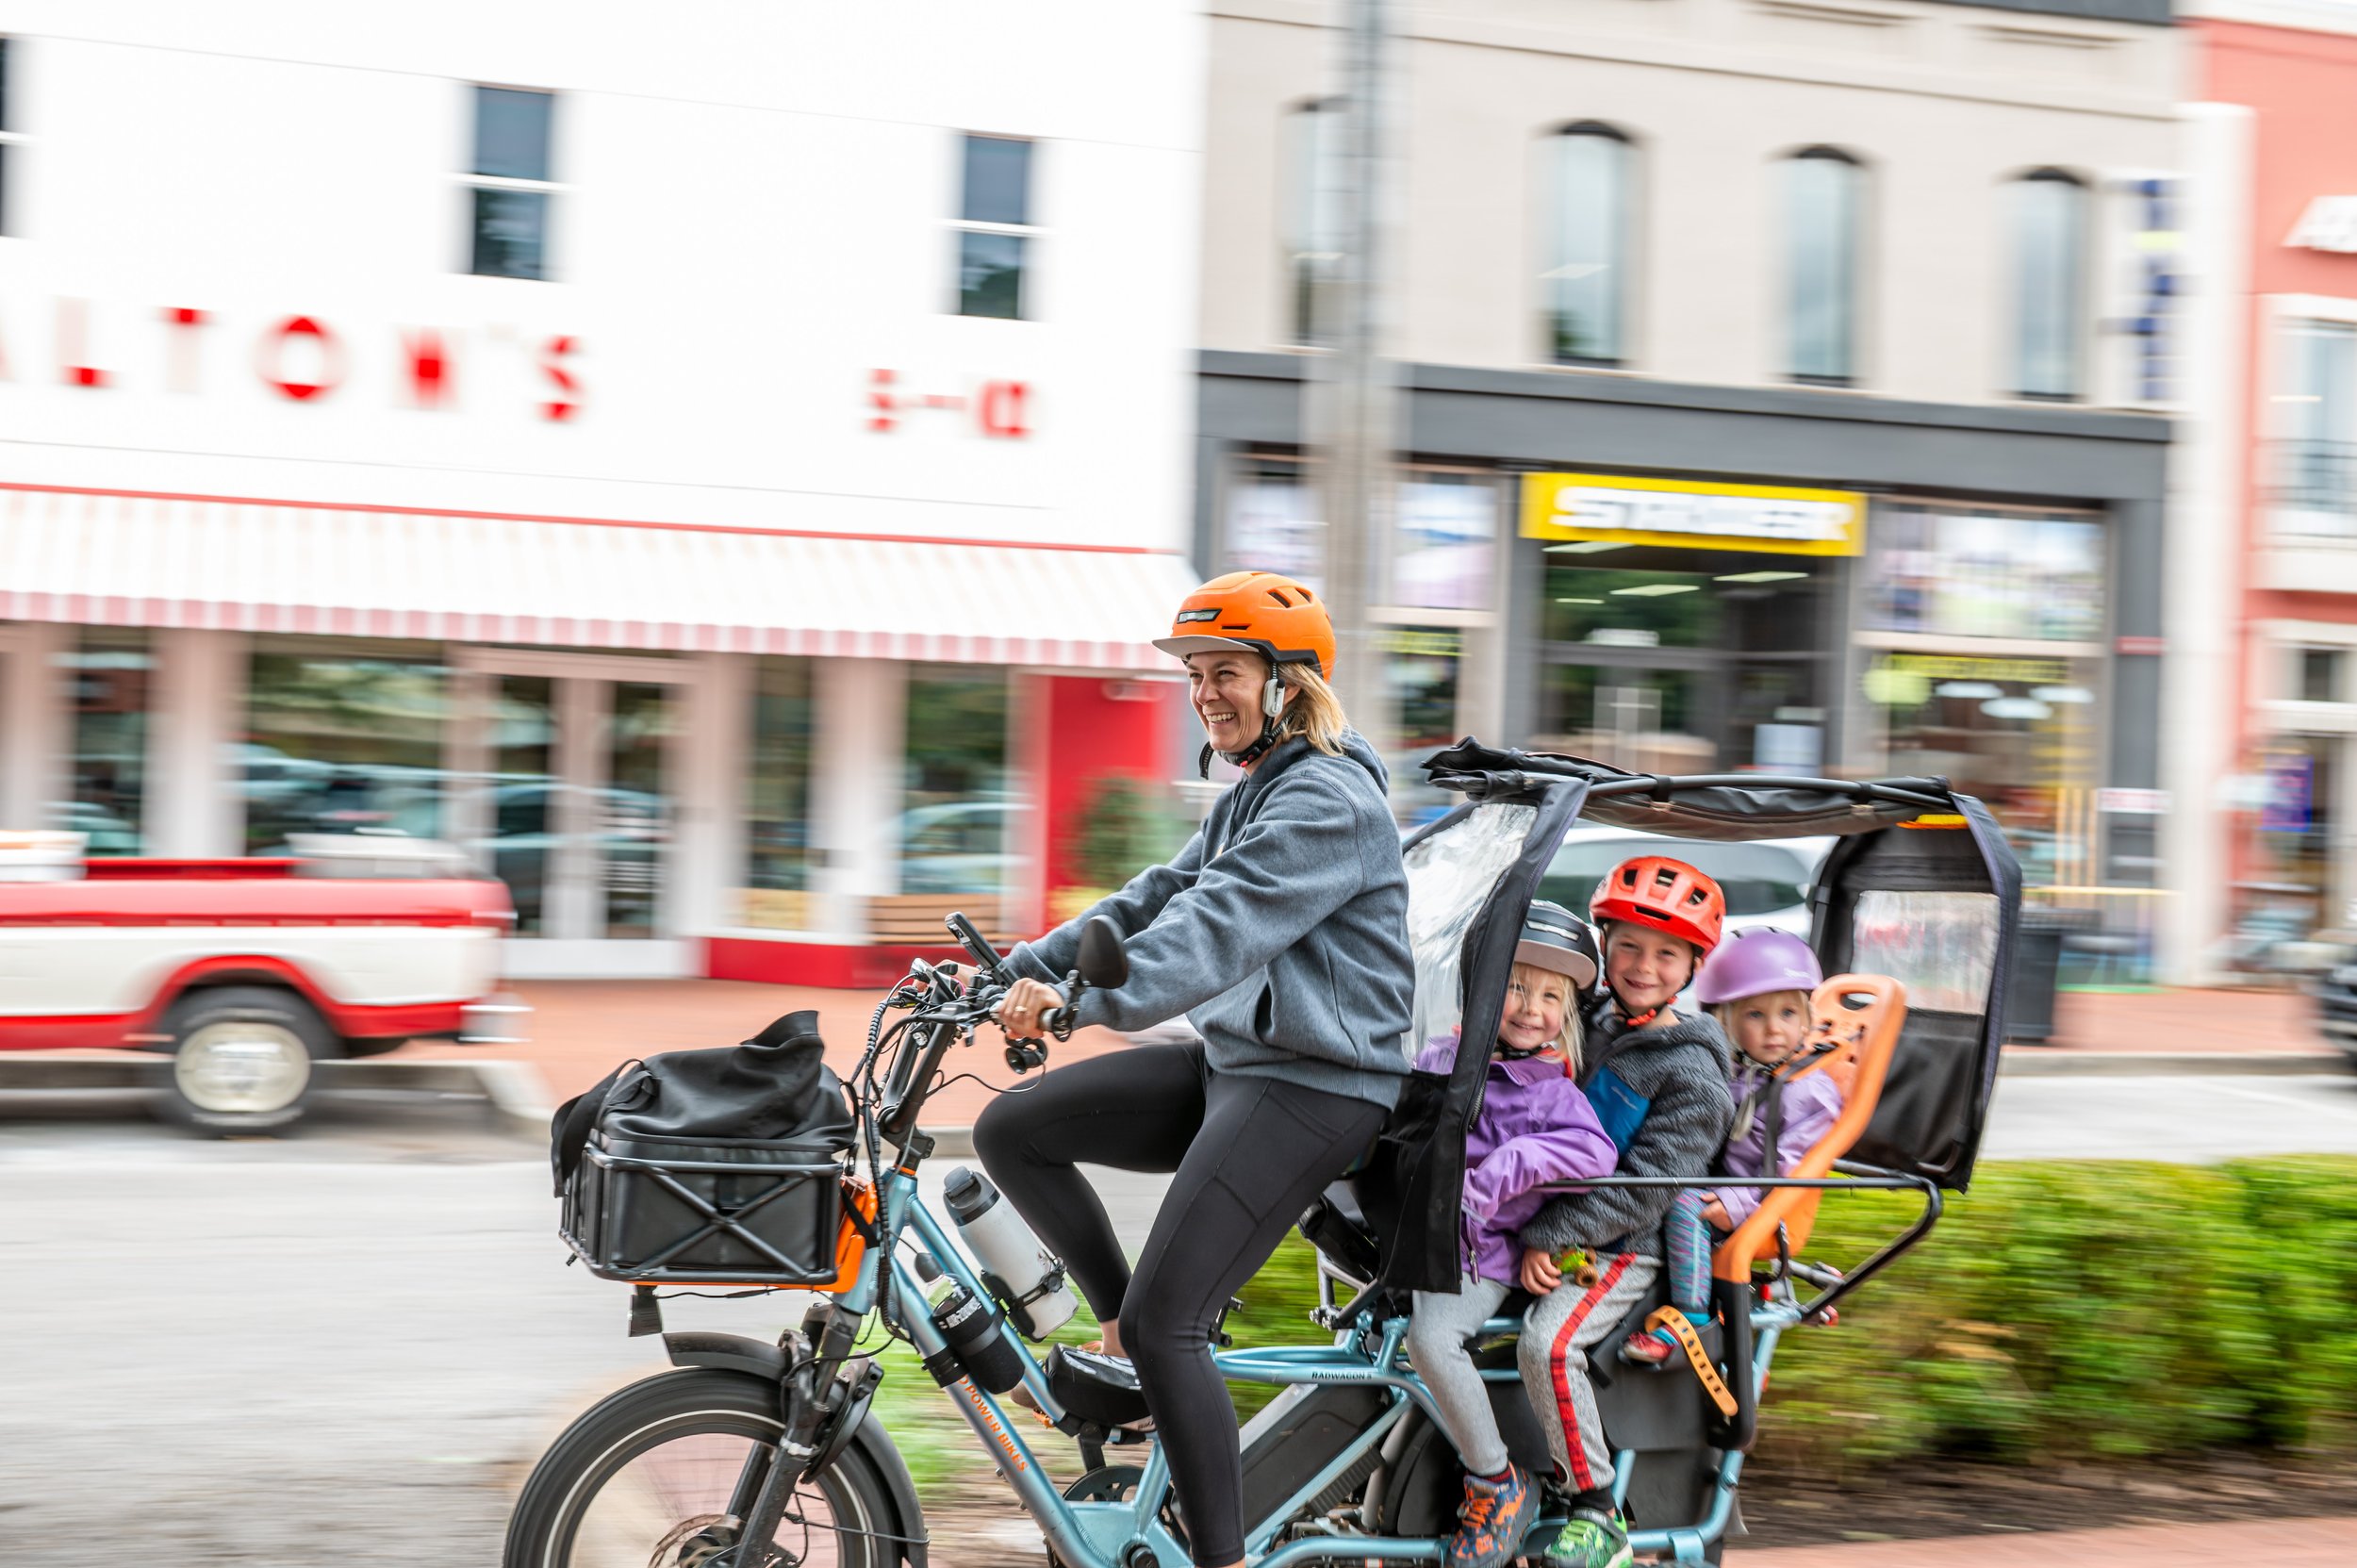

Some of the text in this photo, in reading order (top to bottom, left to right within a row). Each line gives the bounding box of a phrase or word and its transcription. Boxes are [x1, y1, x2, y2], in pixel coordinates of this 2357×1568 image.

[0, 295, 585, 424] LTON'S
[1311, 1371, 1365, 1380] RADWAGON
[964, 1386, 1029, 1472] POWER BIKES
